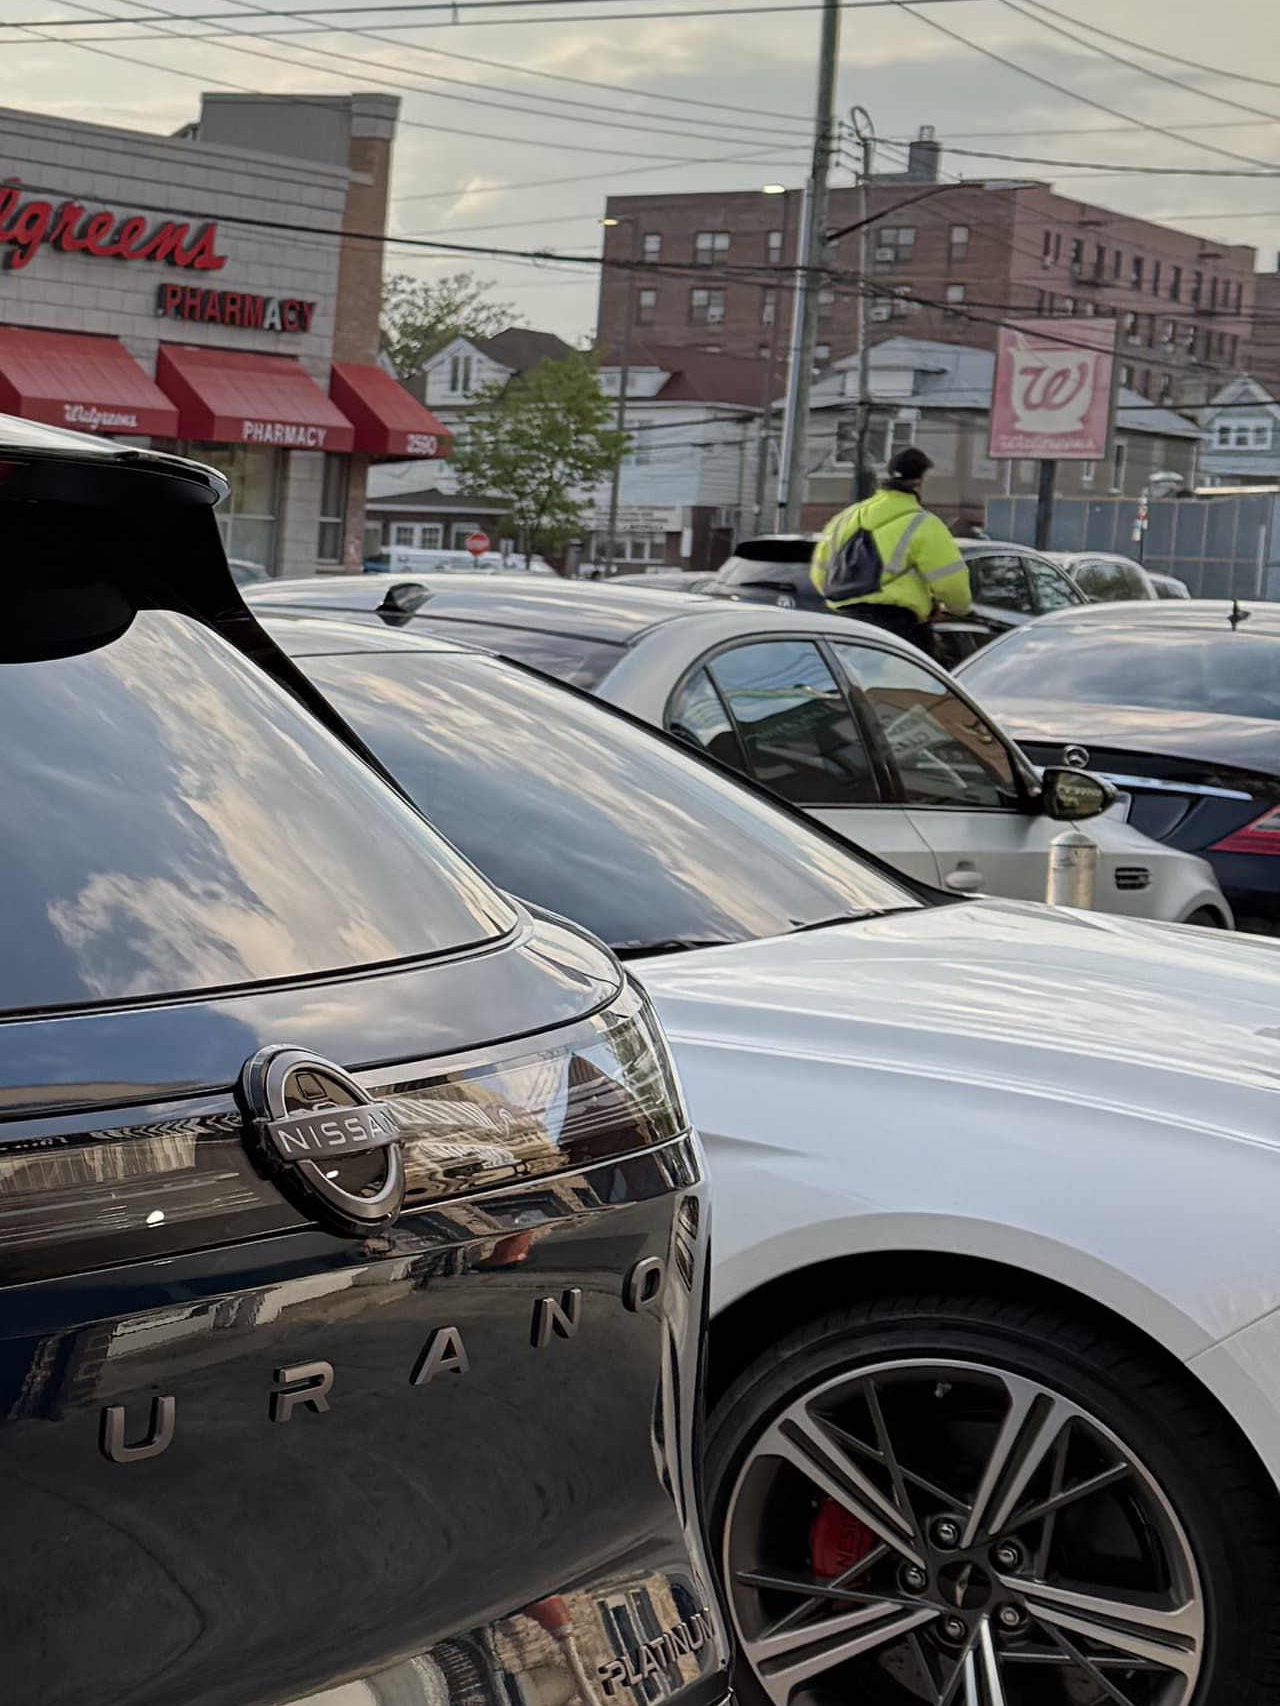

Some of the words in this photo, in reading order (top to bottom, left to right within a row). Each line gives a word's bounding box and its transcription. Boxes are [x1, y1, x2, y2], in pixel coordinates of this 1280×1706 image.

[159, 282, 317, 333] PHARMACY
[63, 404, 138, 430] Walgreens
[242, 420, 328, 447] PHARMACY
[277, 1111, 401, 1153] NISSAN
[598, 1607, 716, 1696] PLATINUM
